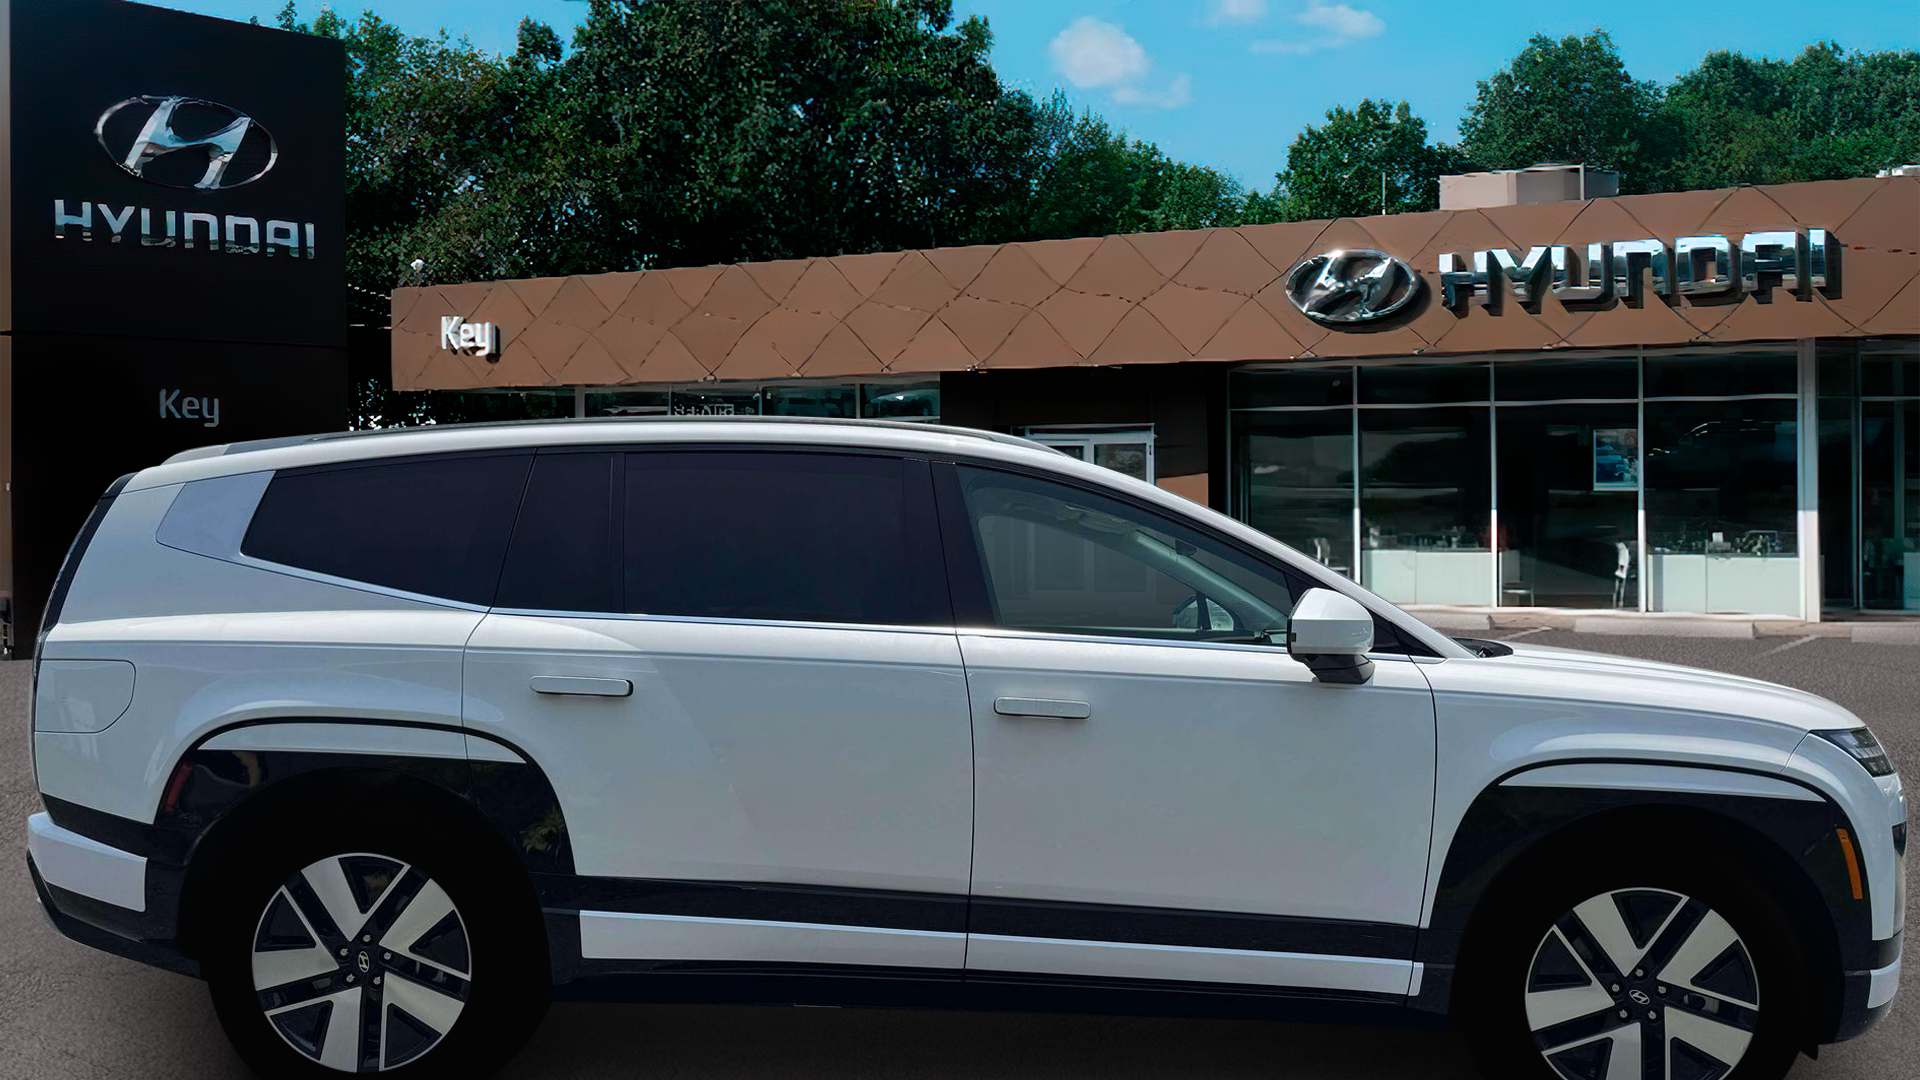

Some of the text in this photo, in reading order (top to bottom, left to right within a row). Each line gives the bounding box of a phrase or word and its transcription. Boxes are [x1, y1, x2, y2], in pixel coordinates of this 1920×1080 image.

[54, 199, 315, 259] HYUNDAI
[1438, 228, 1832, 308] HYUNDAI
[441, 315, 492, 357] Key
[159, 388, 220, 427] Key
